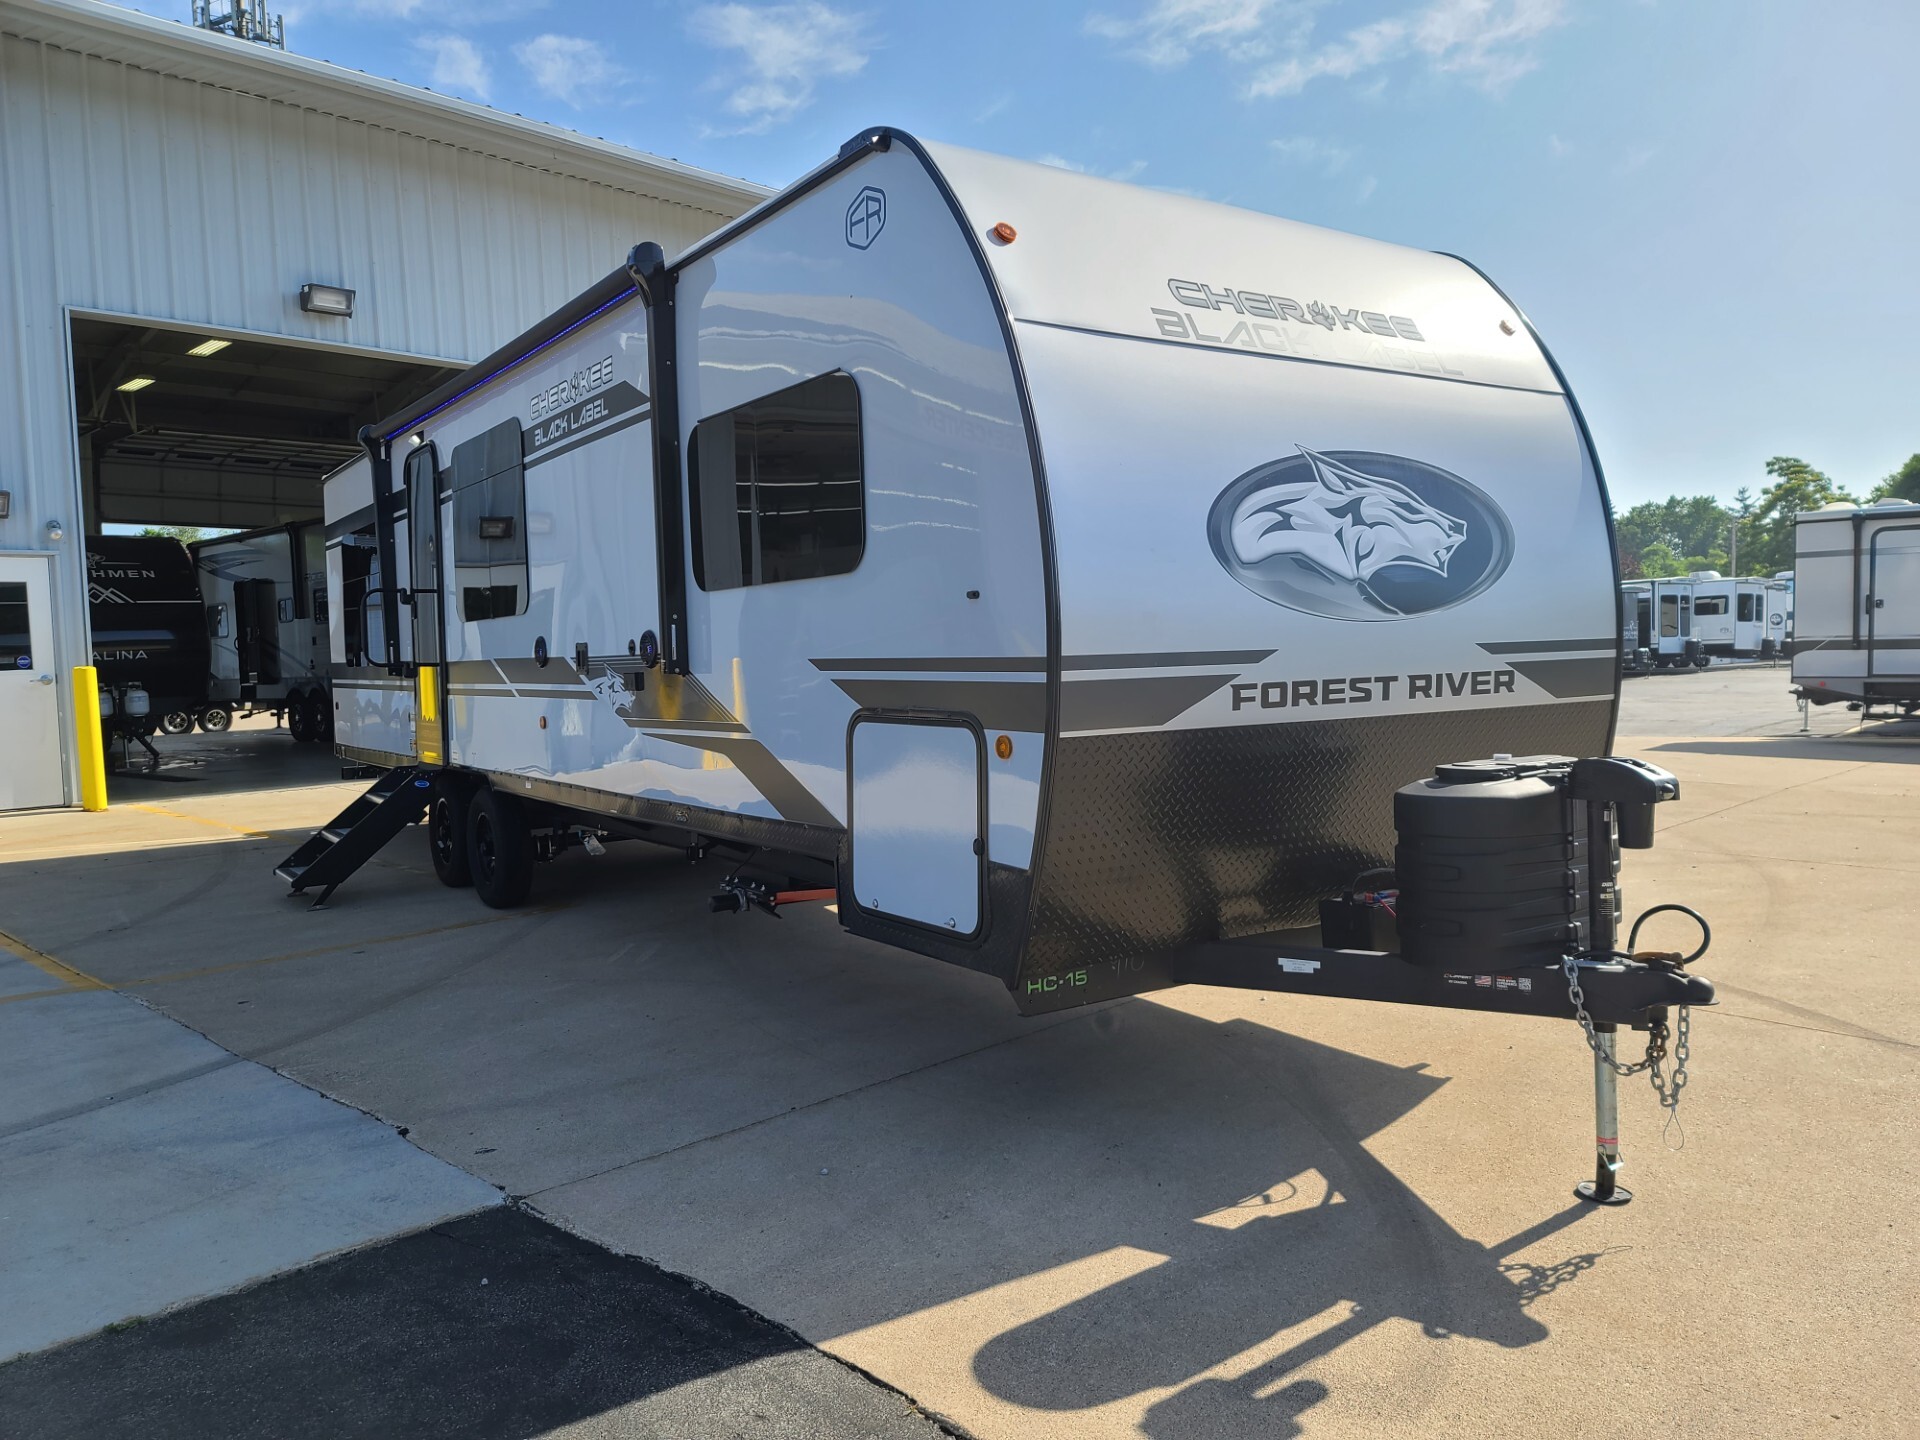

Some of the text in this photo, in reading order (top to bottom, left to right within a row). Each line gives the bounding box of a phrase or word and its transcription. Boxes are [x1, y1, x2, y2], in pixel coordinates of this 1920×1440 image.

[1150, 307, 1311, 354] BLACK
[534, 397, 609, 447] BLACK LABEL
[90, 569, 156, 578] HMEN
[92, 650, 149, 661] ALINA
[1229, 669, 1516, 711] FOREST RIVER
